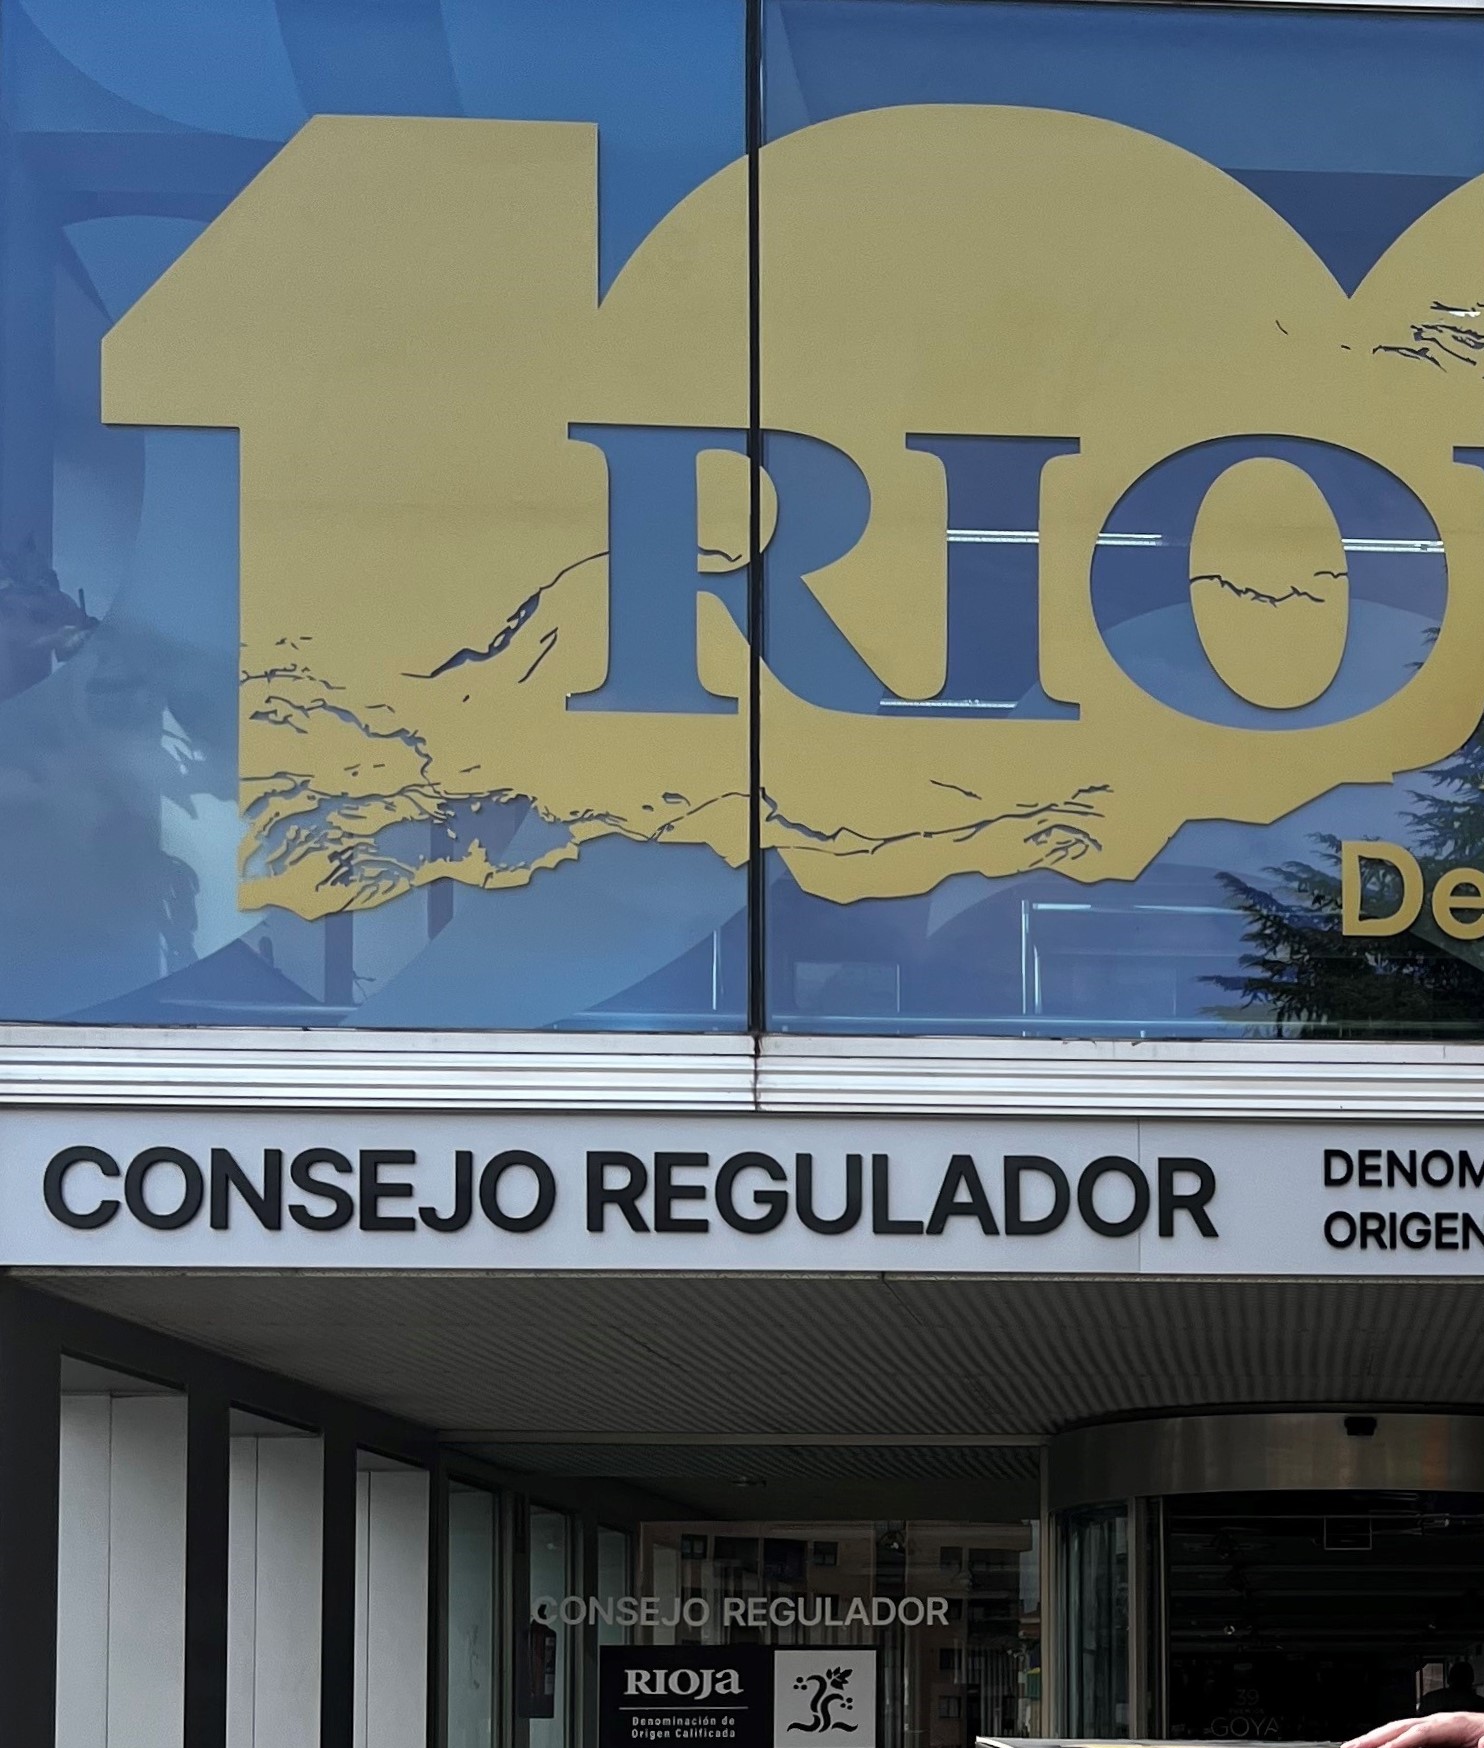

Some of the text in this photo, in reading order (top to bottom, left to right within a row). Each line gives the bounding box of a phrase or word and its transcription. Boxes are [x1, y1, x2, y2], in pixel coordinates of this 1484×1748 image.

[43, 1145, 1220, 1240] CONSEJO REGULADOR
[531, 1596, 949, 1627] CONSEJO REGULADOR
[1236, 1689, 1259, 1705] 39
[632, 1714, 735, 1727] Denominación de
[1211, 1717, 1279, 1736] GOYA
[631, 1727, 736, 1740] Origen Calificada
